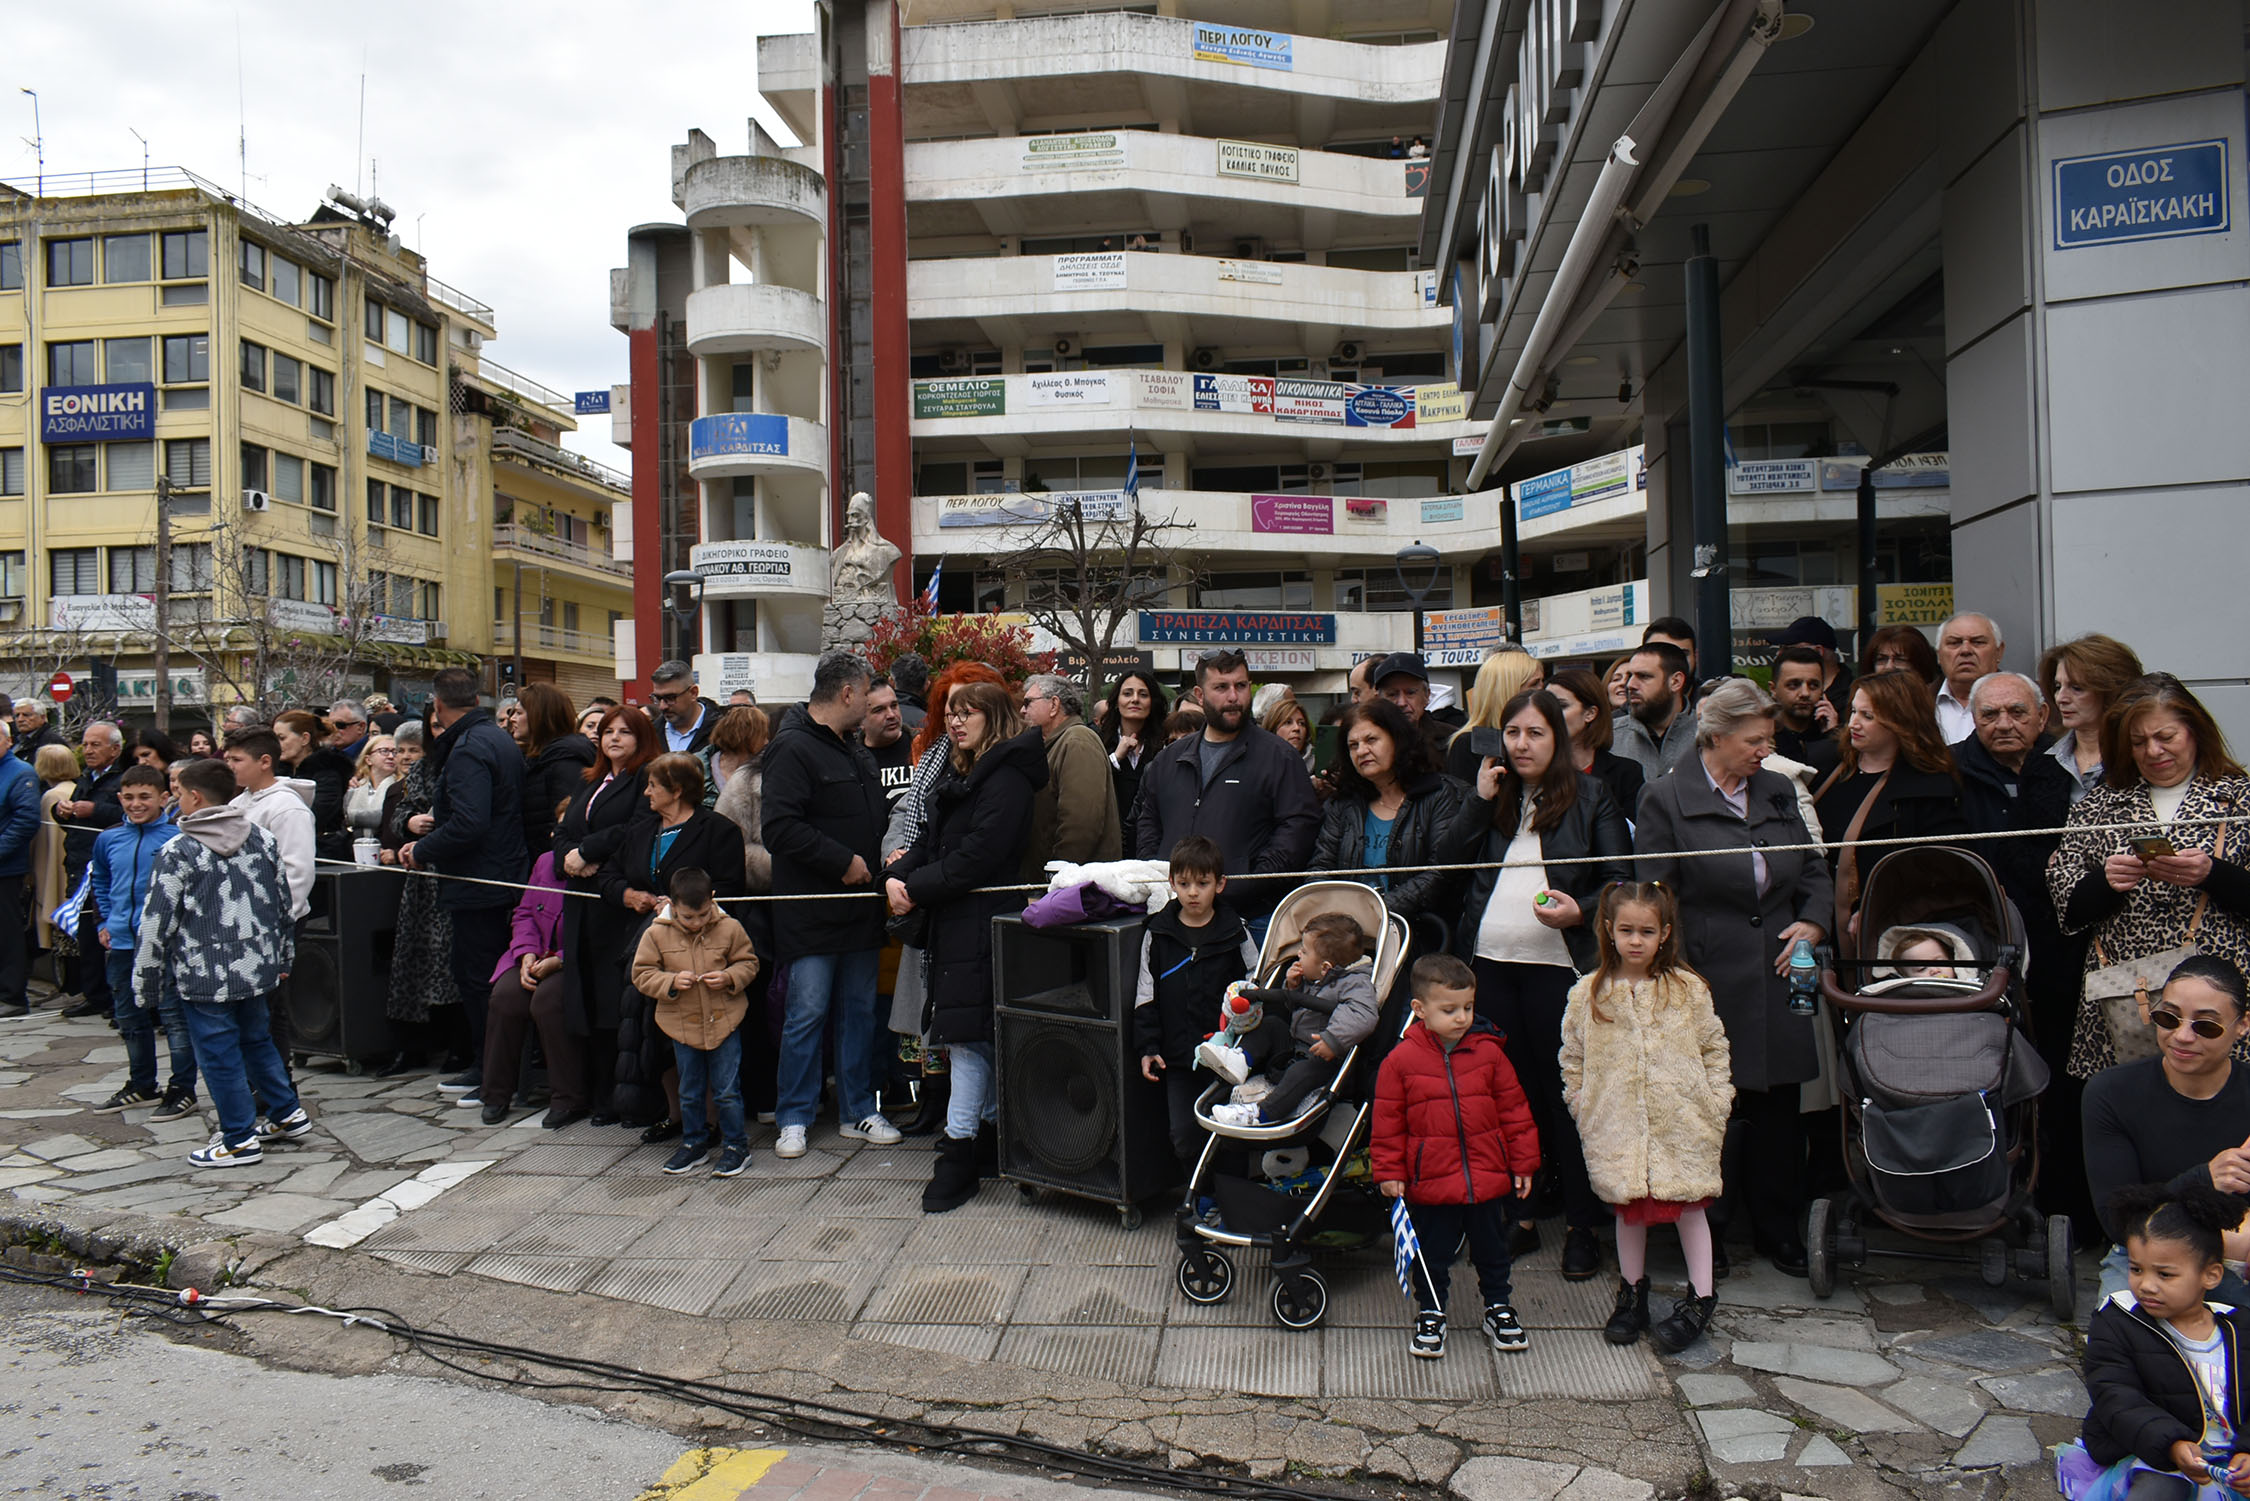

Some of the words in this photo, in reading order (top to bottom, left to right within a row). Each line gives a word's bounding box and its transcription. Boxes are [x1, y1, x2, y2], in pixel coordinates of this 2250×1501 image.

[1198, 29, 1226, 45] ΠΕΡΙ
[1230, 33, 1272, 48] ΛΟΓΟΥ
[1228, 46, 1257, 58] Ειδικής
[1222, 146, 1261, 159] ΛΟΓΙΣΤΙΚΟ
[1264, 150, 1295, 163] ΓΡΑΦΕΙΟ
[1226, 160, 1256, 172] ΚΑΛΛΙΑΣ
[1260, 163, 1290, 176] ΠΑΥΛΟΣ
[2106, 158, 2174, 188] ΟΔΟΣ
[2071, 193, 2214, 231] ΚΑΡΑΪΣΚΑΚΗ
[1058, 255, 1123, 263] ΠΡΟΓΡΑΜΜΑΤΑ
[1060, 263, 1097, 271] ΔΗΛΩΣΕΙΣ
[1032, 380, 1063, 389] Αχιλλέας
[1074, 377, 1106, 387] Μπόγκας
[1139, 374, 1184, 384] ΤΣΑΒΑΛΟΥ
[929, 381, 990, 392] ΘΕΜΕΛΙΟ
[1148, 386, 1176, 395] ΣΟΦΙΑ
[1200, 379, 1268, 394] ΓΑΛΛΙΚΑ
[1276, 381, 1343, 399] ΟΙΚΟΝΟΜΙΚΑ
[918, 391, 971, 400] ΚΟΡΚΟΝΤΖΕΛΟΣ
[1054, 390, 1084, 399] Φυσικός
[1195, 391, 1239, 402] ΕΛΙΣΣΑΒΕΤ
[47, 391, 145, 415] ΕΘΝΙΚΗ
[923, 405, 954, 413] ΖΕΥΓΑΡΑ
[955, 402, 996, 411] ΣΤΑΥΡΟΥΛΑ
[1295, 399, 1324, 408] ΝΙΚΟΣ
[1380, 401, 1404, 409] ΓΑΛΛΙΚΑ
[1276, 408, 1343, 417] ΚΑΚΑΡΙΜΠΑΣ
[1420, 404, 1461, 418] ΜΑΚΡΥΝΙΚΑ
[46, 414, 145, 434] ΑΣΦΑΛΙΣΤΙΚΗ
[720, 443, 781, 454] ΚΑΡΔΙΤΣΑΣ
[1521, 472, 1570, 497] ΓΕΡΜΑΝΙΚΑ
[945, 498, 968, 508] ΠΕΡΙ
[970, 497, 1005, 508] ΛΟΓΟΥ
[1274, 502, 1302, 510] Χριστίνα
[1303, 503, 1330, 512] Βαγγέλη
[702, 548, 747, 560] ΔΙΚΗΓΟΡΙΚΟ
[750, 549, 789, 559] ΓΡΑΦΕΙΟ
[748, 562, 789, 574] ΓΕΩΡΓΙΑΣ
[1155, 614, 1230, 629] ΤΡΑΠΕΖΑ
[1236, 615, 1325, 630] ΚΑΡΔΙΤΣΑΣ
[1444, 612, 1489, 622] ΕΡΓΑΣΤΗΡΙΟ
[1431, 619, 1498, 630] ΦΥΣΙΚΟΘΕΡΑΠΕΙΑΣ
[1152, 630, 1325, 642] ΣΥΝΕΤΑΙΡΙΣΤΙΚΗ
[1441, 650, 1480, 664] TOURS
